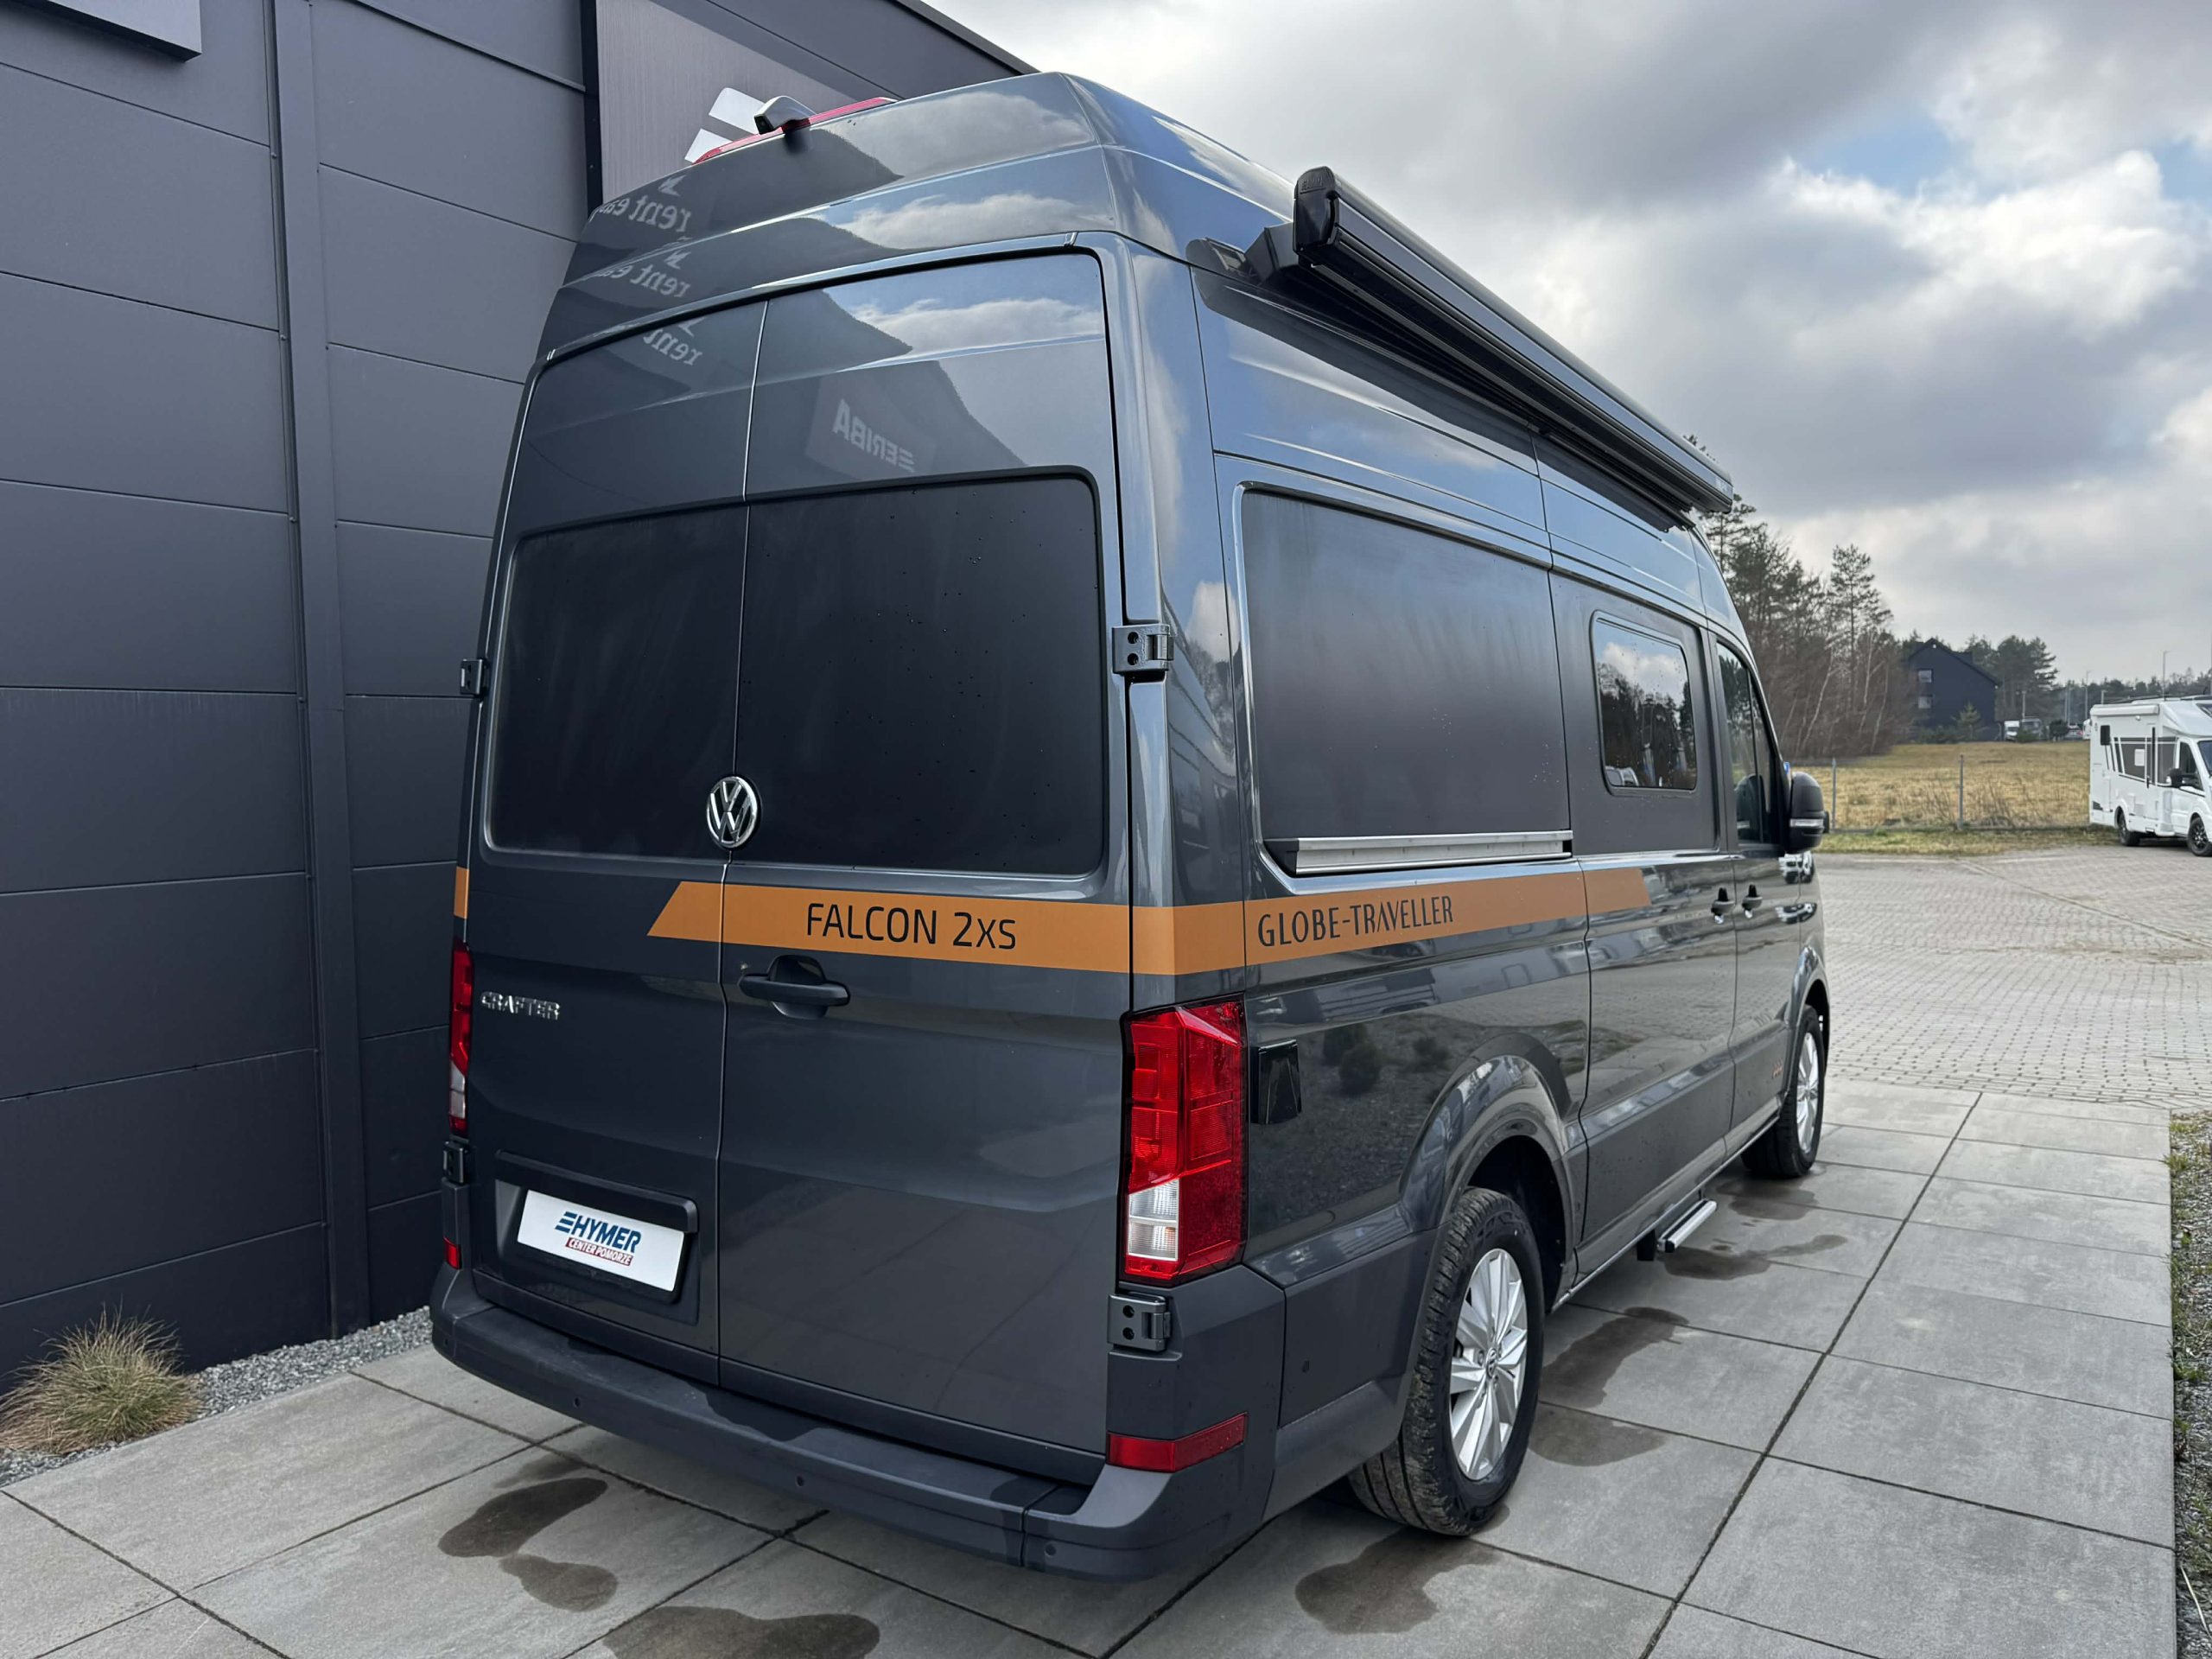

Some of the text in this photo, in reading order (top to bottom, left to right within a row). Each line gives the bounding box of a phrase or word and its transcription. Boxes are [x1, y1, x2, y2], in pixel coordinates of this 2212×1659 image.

[807, 903, 937, 944] FALCON
[1257, 895, 1453, 947] GLOBE-TRAVELLER
[480, 991, 560, 1020] CRAFTER
[569, 1238, 632, 1265] CENTER POMORZE
[570, 1215, 642, 1253] HYMER
